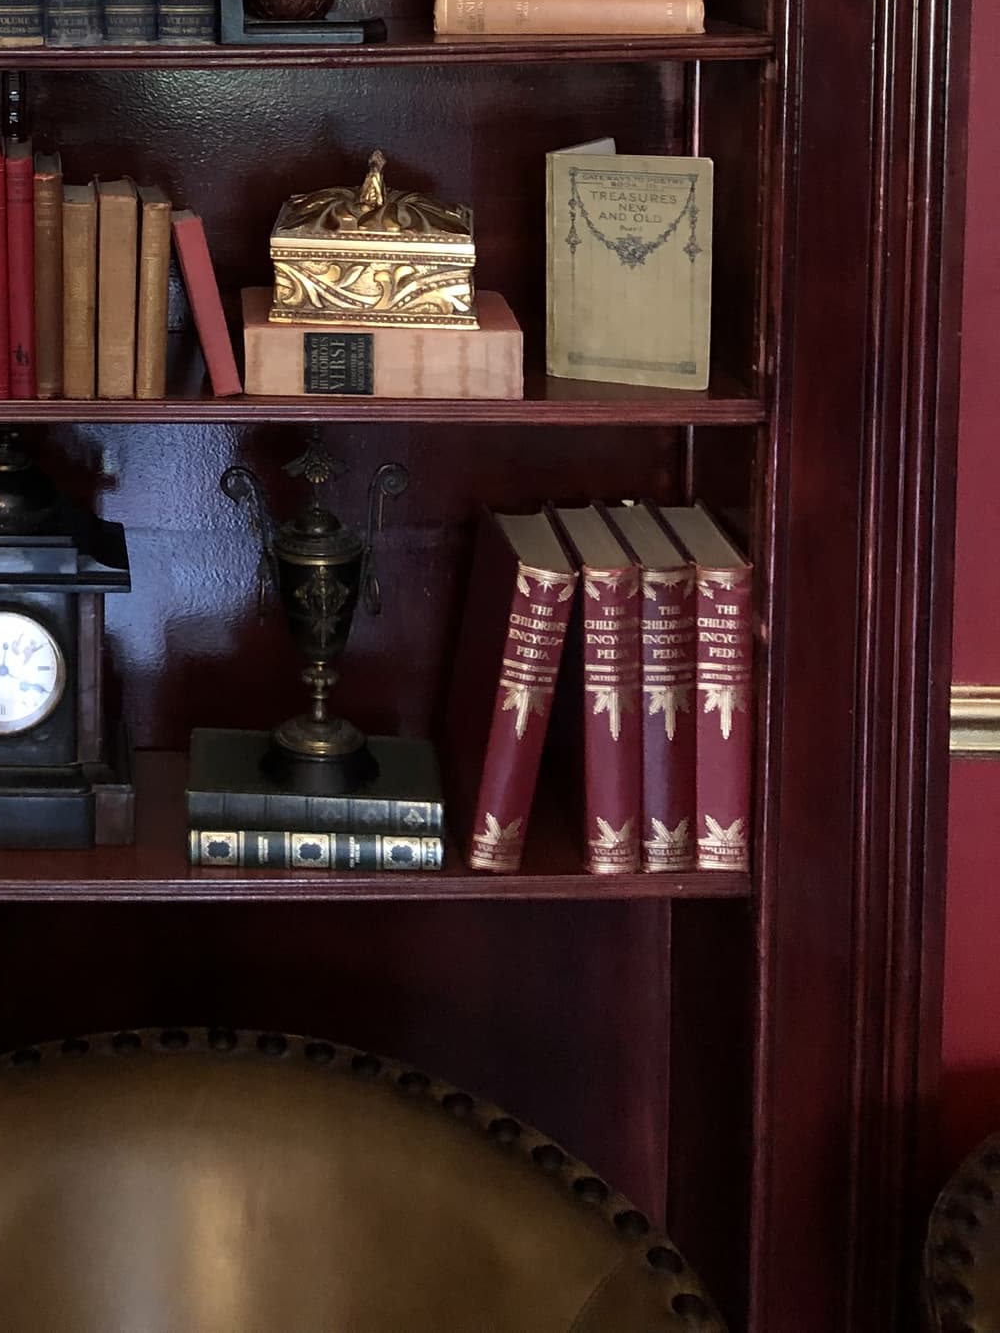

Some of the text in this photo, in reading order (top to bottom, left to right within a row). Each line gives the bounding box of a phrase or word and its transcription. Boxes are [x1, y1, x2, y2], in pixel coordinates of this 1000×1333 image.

[590, 190, 678, 205] TREASURES
[618, 203, 648, 213] NEW
[598, 212, 662, 224] AND OLD
[311, 349, 319, 372] BOOK
[329, 337, 346, 390] VERSE
[530, 603, 554, 617] THE
[658, 606, 681, 616] THE
[715, 604, 739, 616] THE
[508, 627, 563, 646] ENCYCLO-
[516, 645, 550, 661] PEDIA
